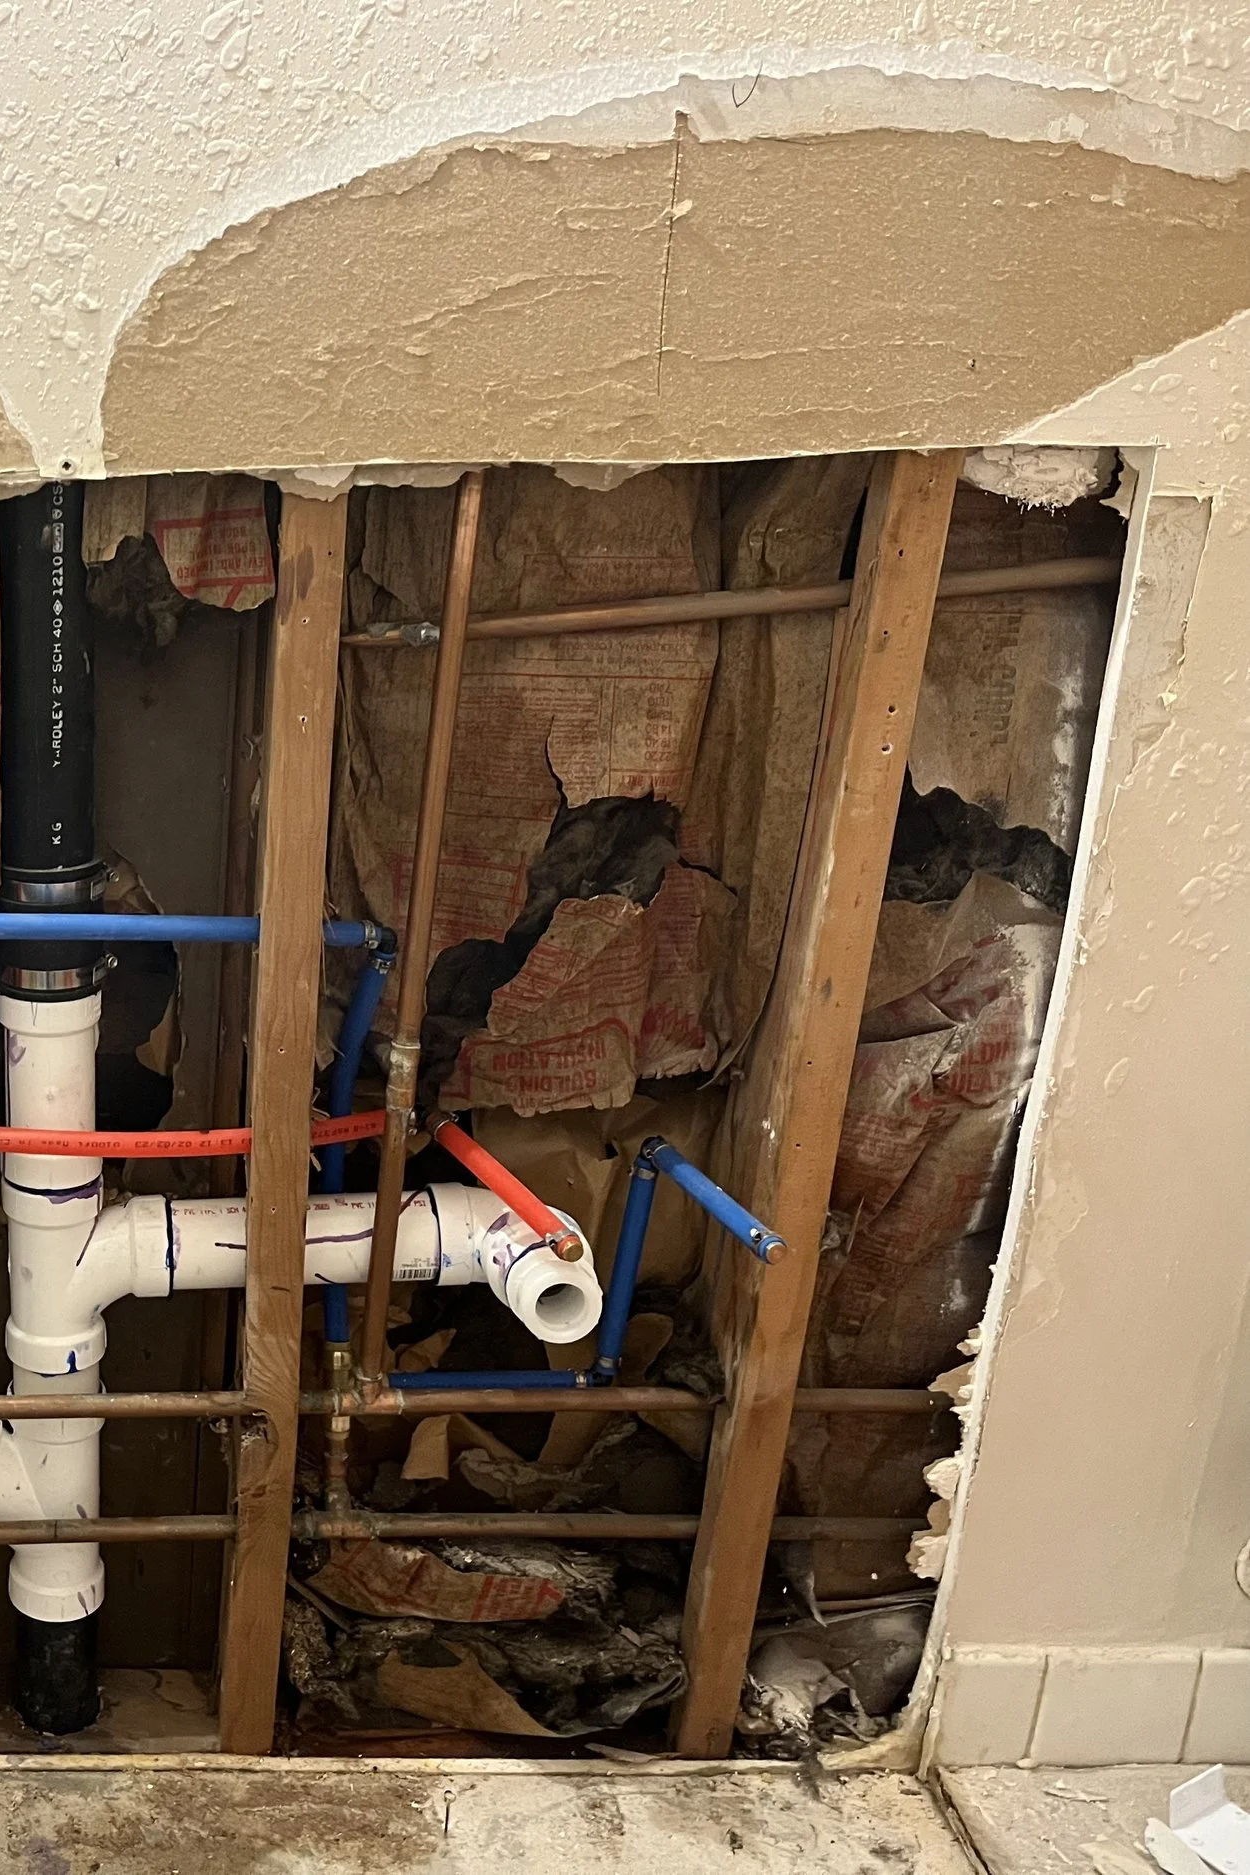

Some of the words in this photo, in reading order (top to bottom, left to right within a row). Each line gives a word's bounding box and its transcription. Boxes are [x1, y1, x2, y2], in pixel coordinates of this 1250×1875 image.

[52, 556, 64, 596] 1210
[52, 618, 63, 638] 40
[52, 643, 63, 673] SCH
[505, 1069, 597, 1093] BUILDING
